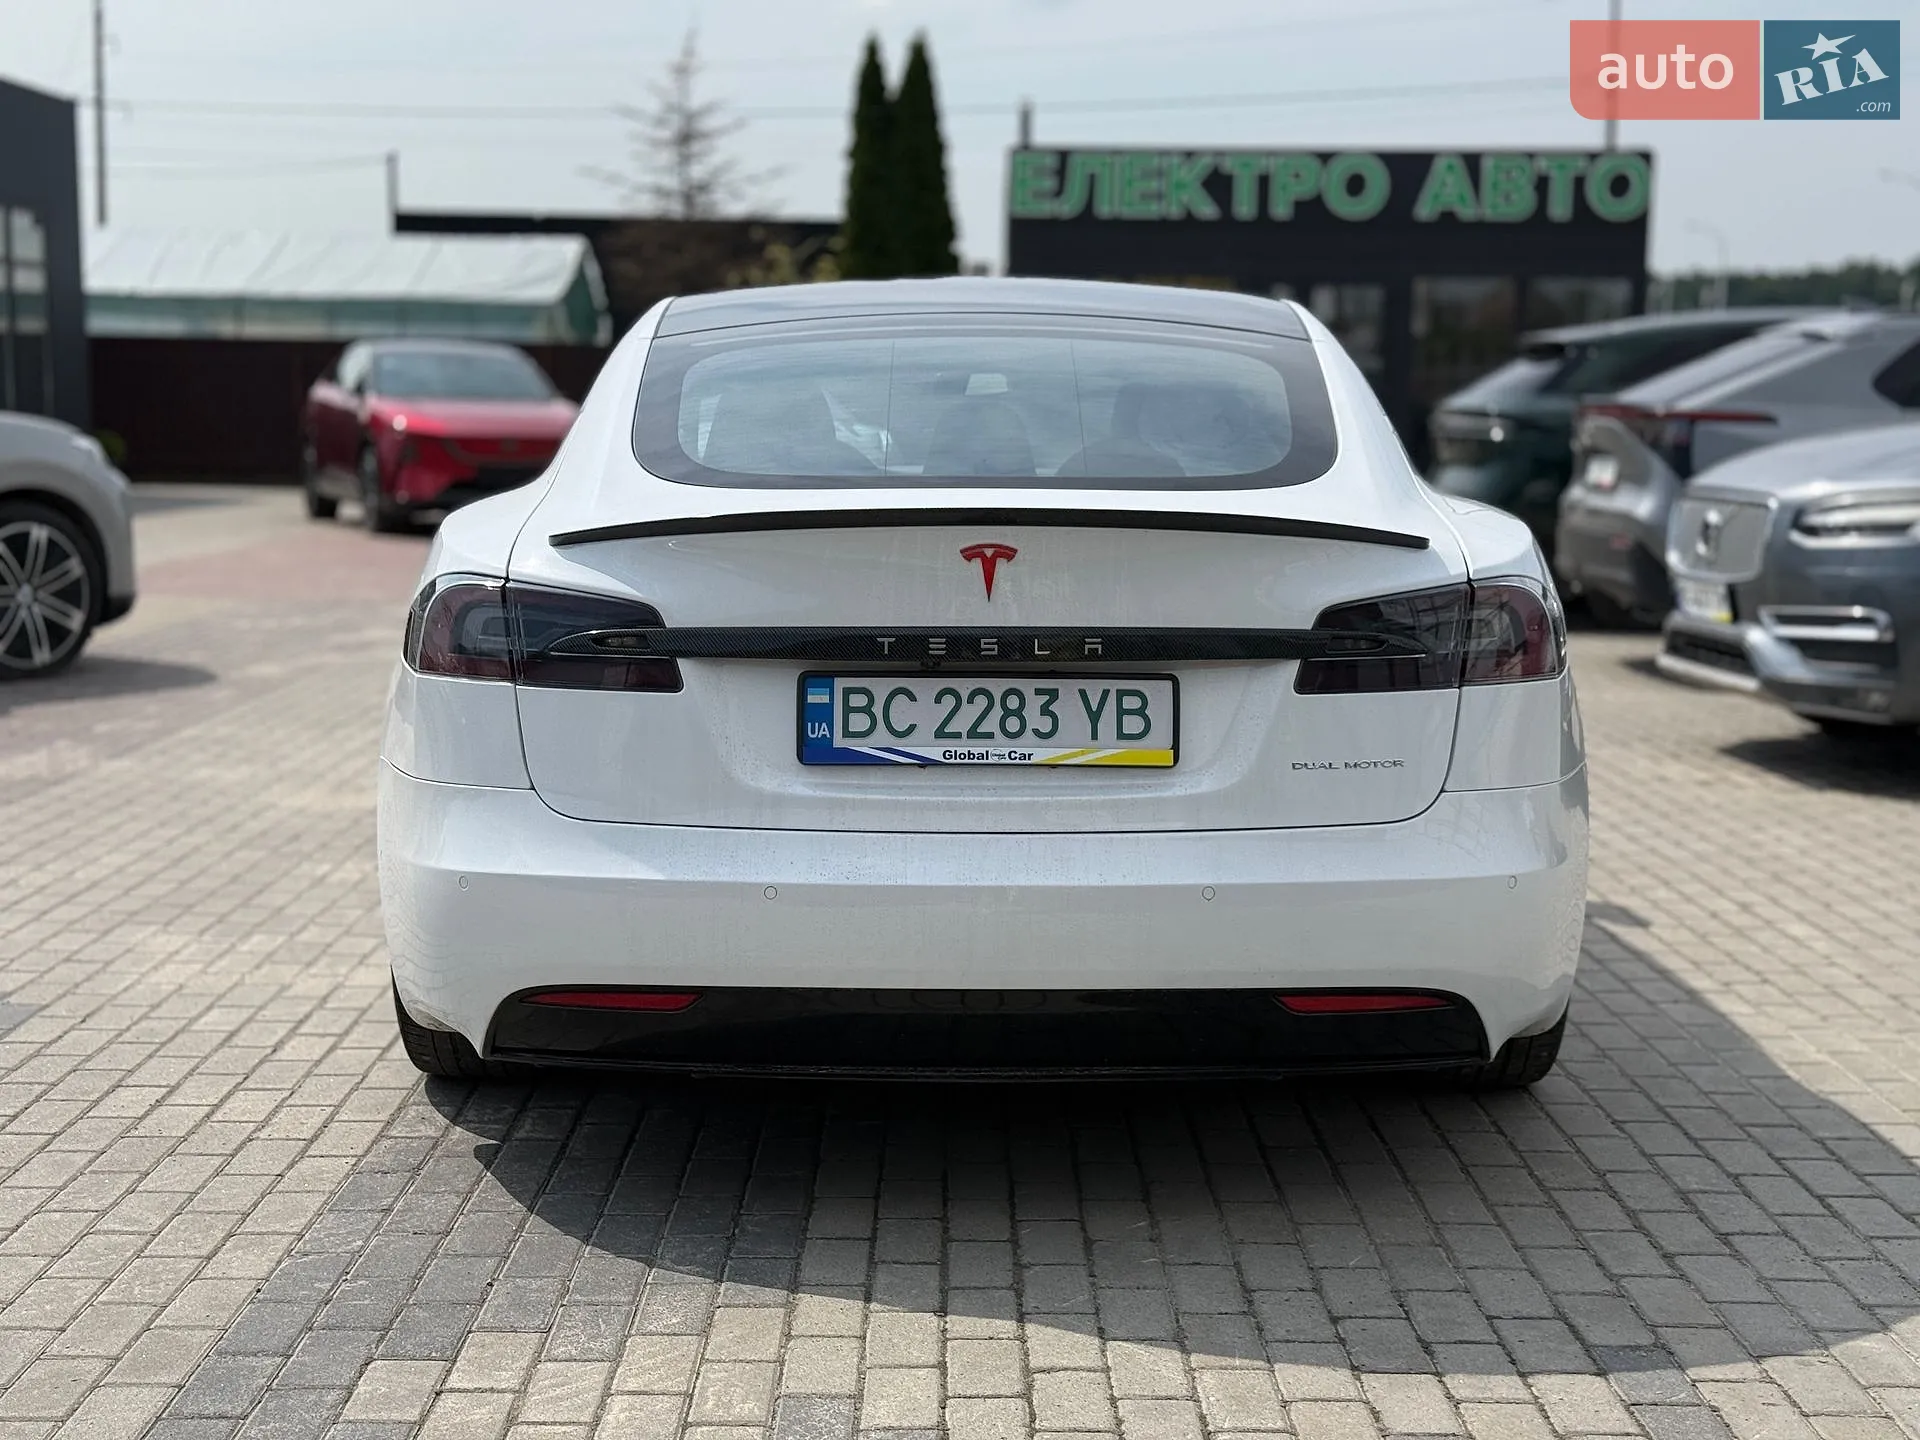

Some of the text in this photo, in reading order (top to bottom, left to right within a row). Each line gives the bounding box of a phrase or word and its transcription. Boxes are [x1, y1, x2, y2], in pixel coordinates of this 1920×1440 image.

[1010, 151, 1652, 222] ЕЛЕКТРО АВТО
[877, 637, 1102, 655] TESLA
[841, 686, 1152, 741] BC 2283 YB
[807, 722, 830, 739] UA
[942, 749, 989, 761] Global
[1007, 750, 1034, 761] Car
[1291, 759, 1405, 770] DUAL MOTOR
